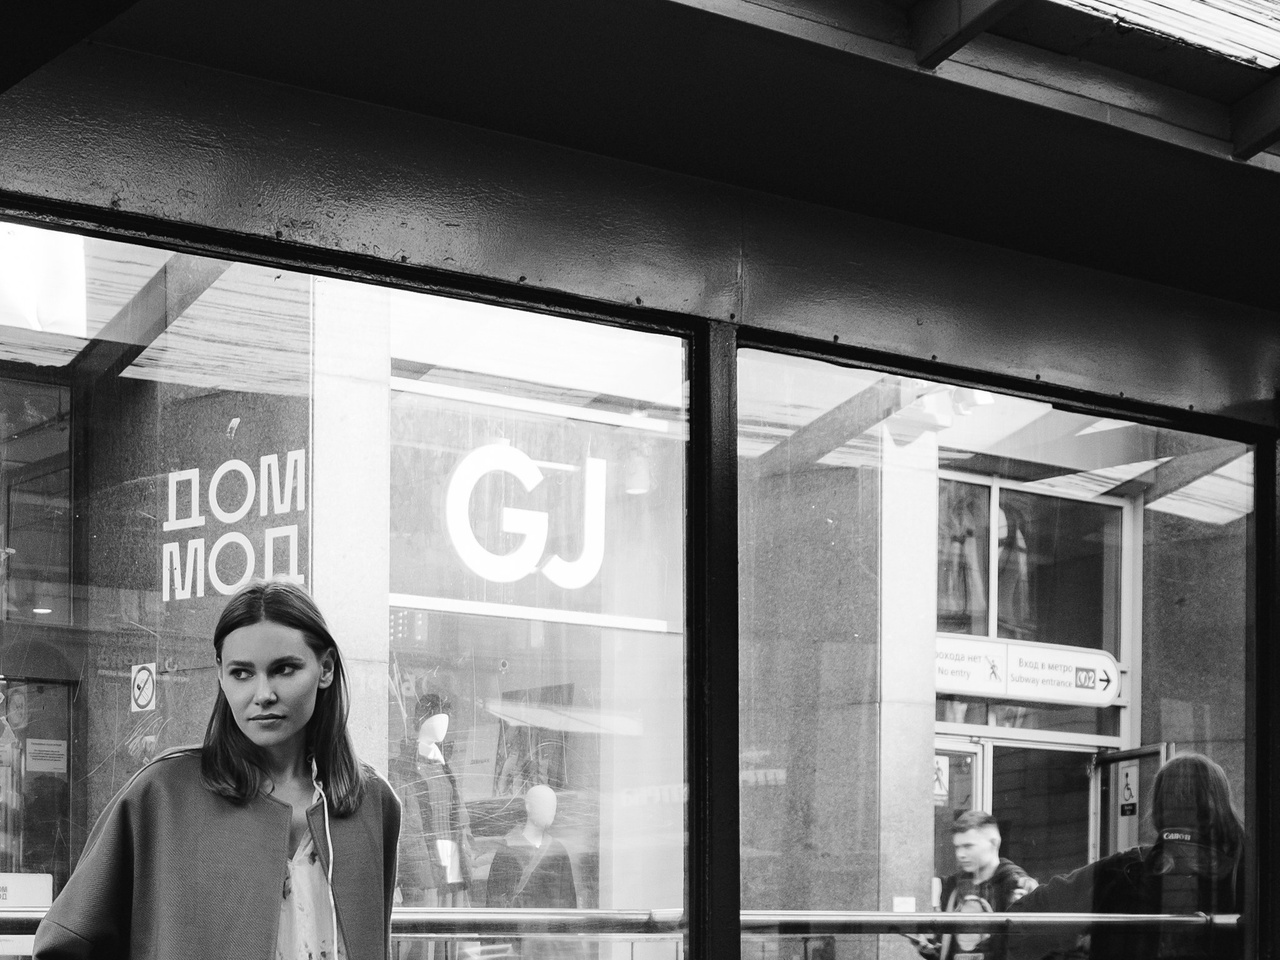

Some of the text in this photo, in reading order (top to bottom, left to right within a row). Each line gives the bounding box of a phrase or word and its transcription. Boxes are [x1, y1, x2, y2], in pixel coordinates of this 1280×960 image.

[162, 449, 306, 531] ДОМ
[446, 439, 607, 589] GJ
[162, 524, 306, 602] МОД
[968, 655, 982, 663] нет
[1018, 657, 1074, 674] Вход в метро
[938, 666, 972, 681] No entry
[1011, 672, 1073, 688] Subway entrance
